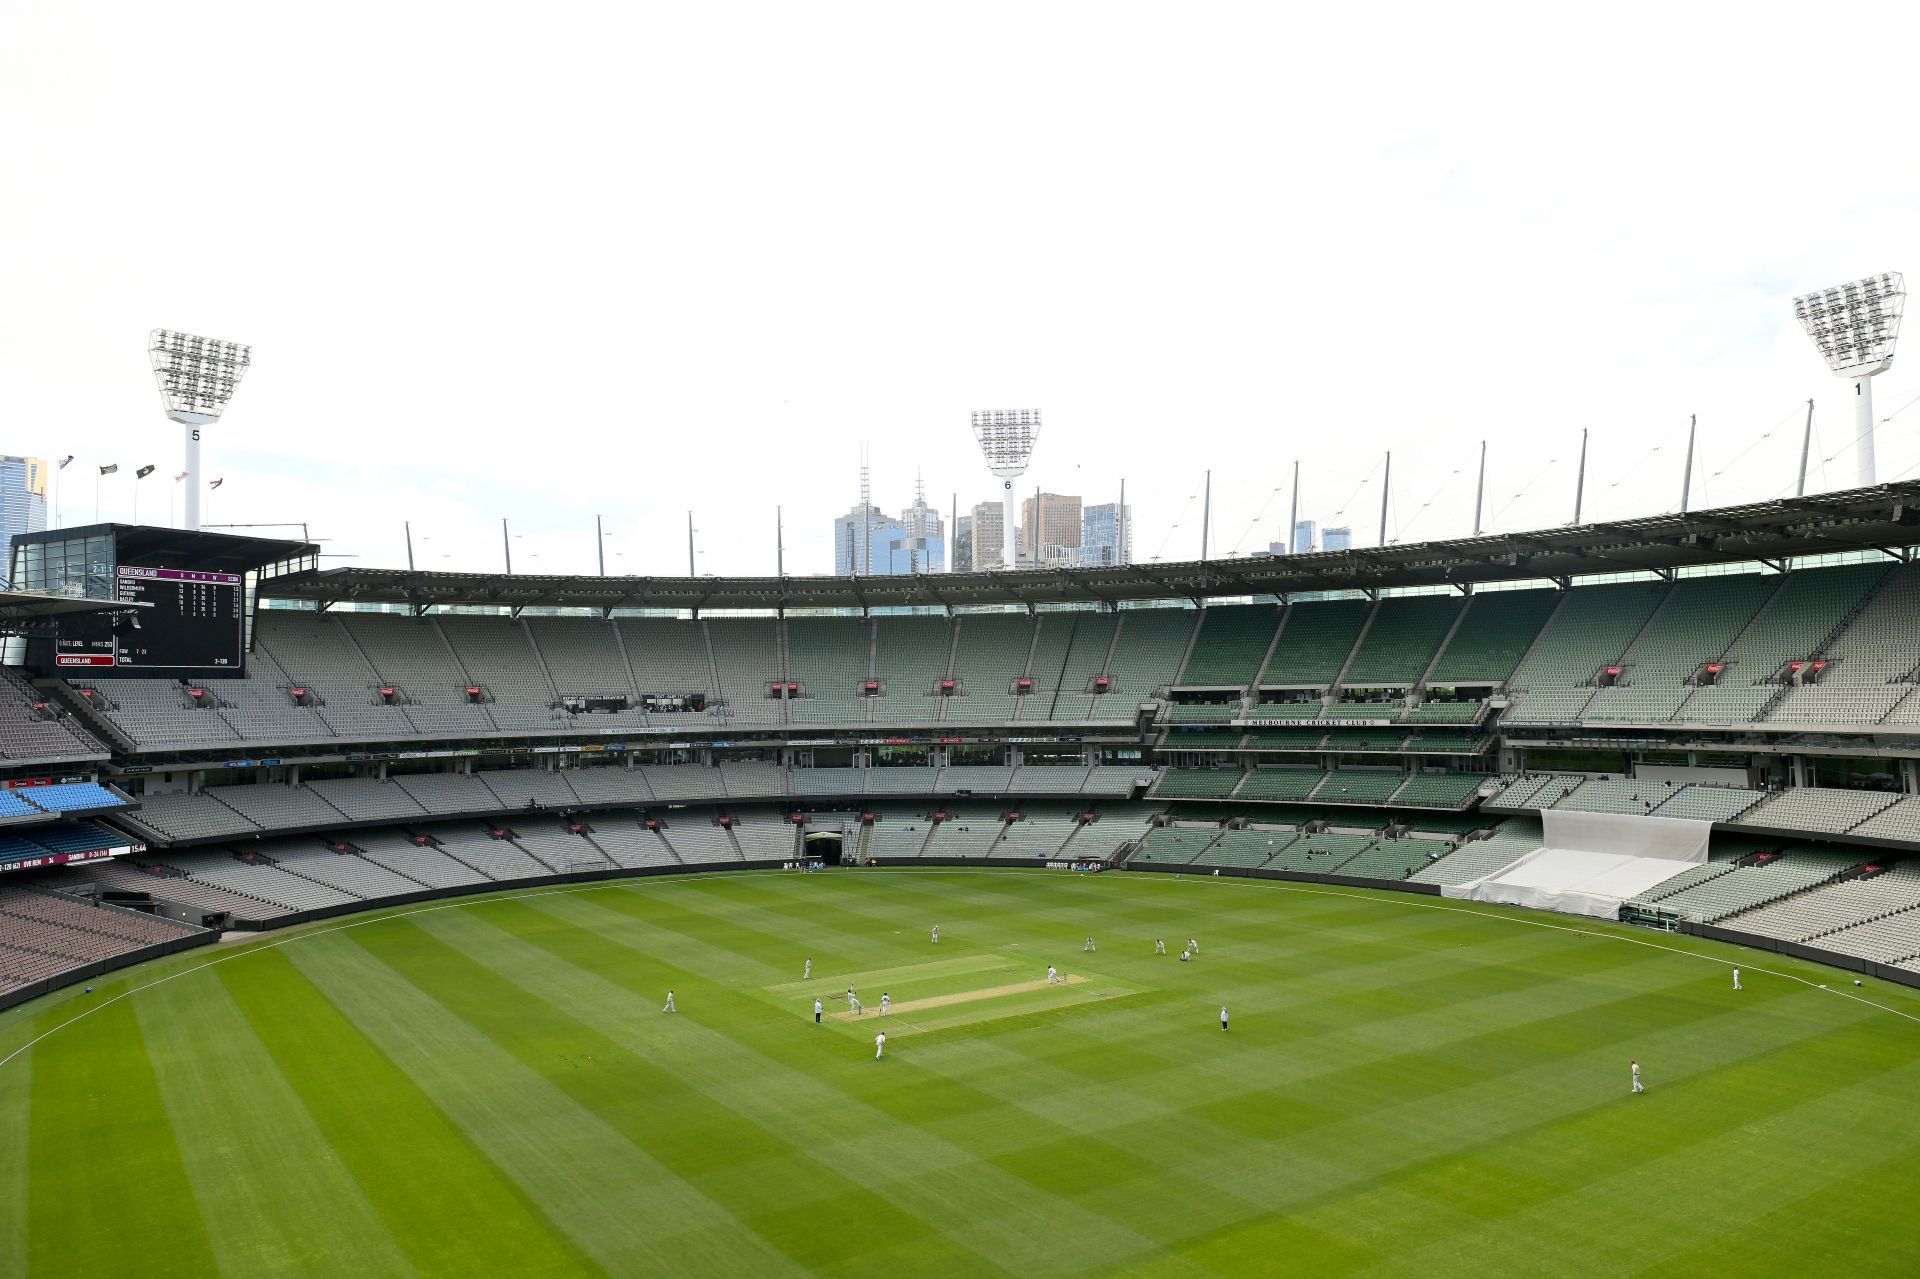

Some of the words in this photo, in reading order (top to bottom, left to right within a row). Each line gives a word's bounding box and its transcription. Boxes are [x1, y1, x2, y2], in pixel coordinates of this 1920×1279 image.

[1854, 383, 1861, 395] 1
[192, 430, 200, 441] 5
[1004, 481, 1011, 490] 6
[120, 568, 157, 577] QUEENSLAND
